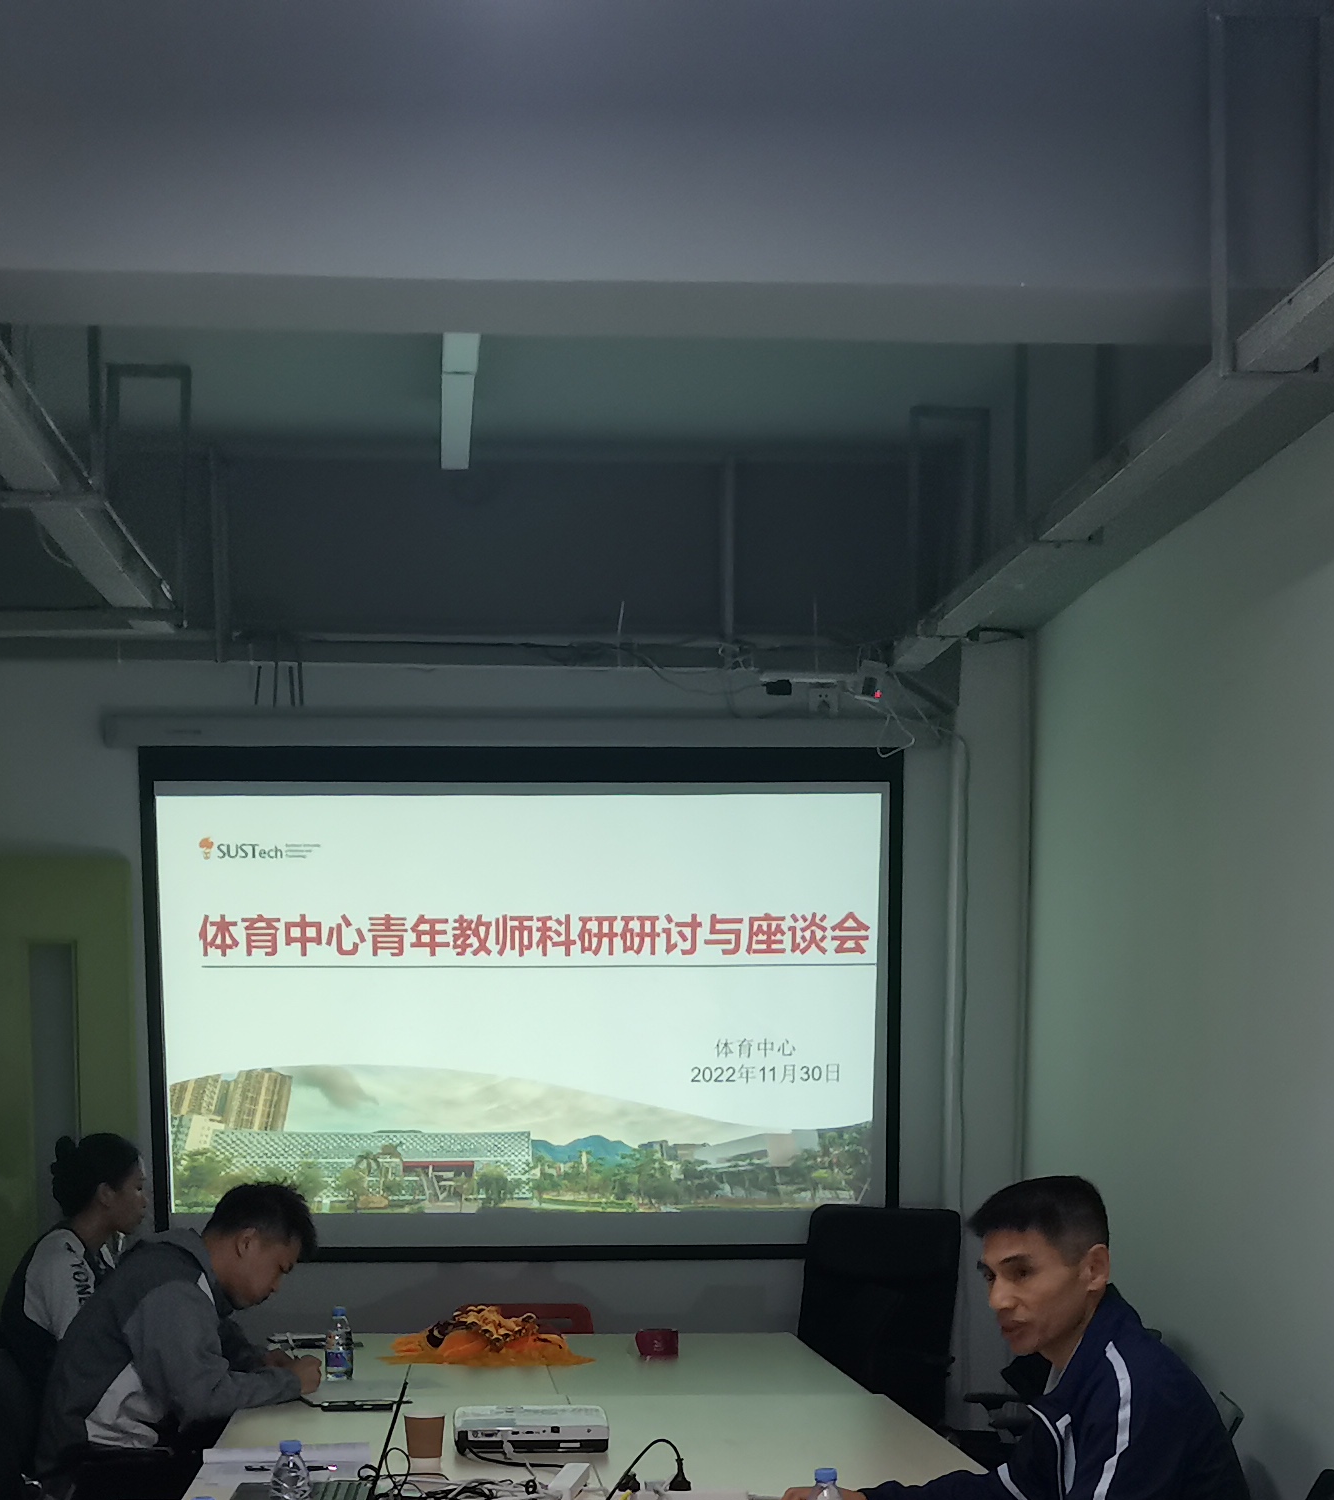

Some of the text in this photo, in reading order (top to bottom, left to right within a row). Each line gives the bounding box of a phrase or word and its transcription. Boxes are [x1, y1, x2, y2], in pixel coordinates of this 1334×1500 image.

[216, 843, 283, 859] SUSTech
[198, 911, 871, 959] 体育中心青年教师科研研讨与座谈会
[714, 1037, 797, 1059] 体育中心
[689, 1062, 841, 1084] 2022年11月30日
